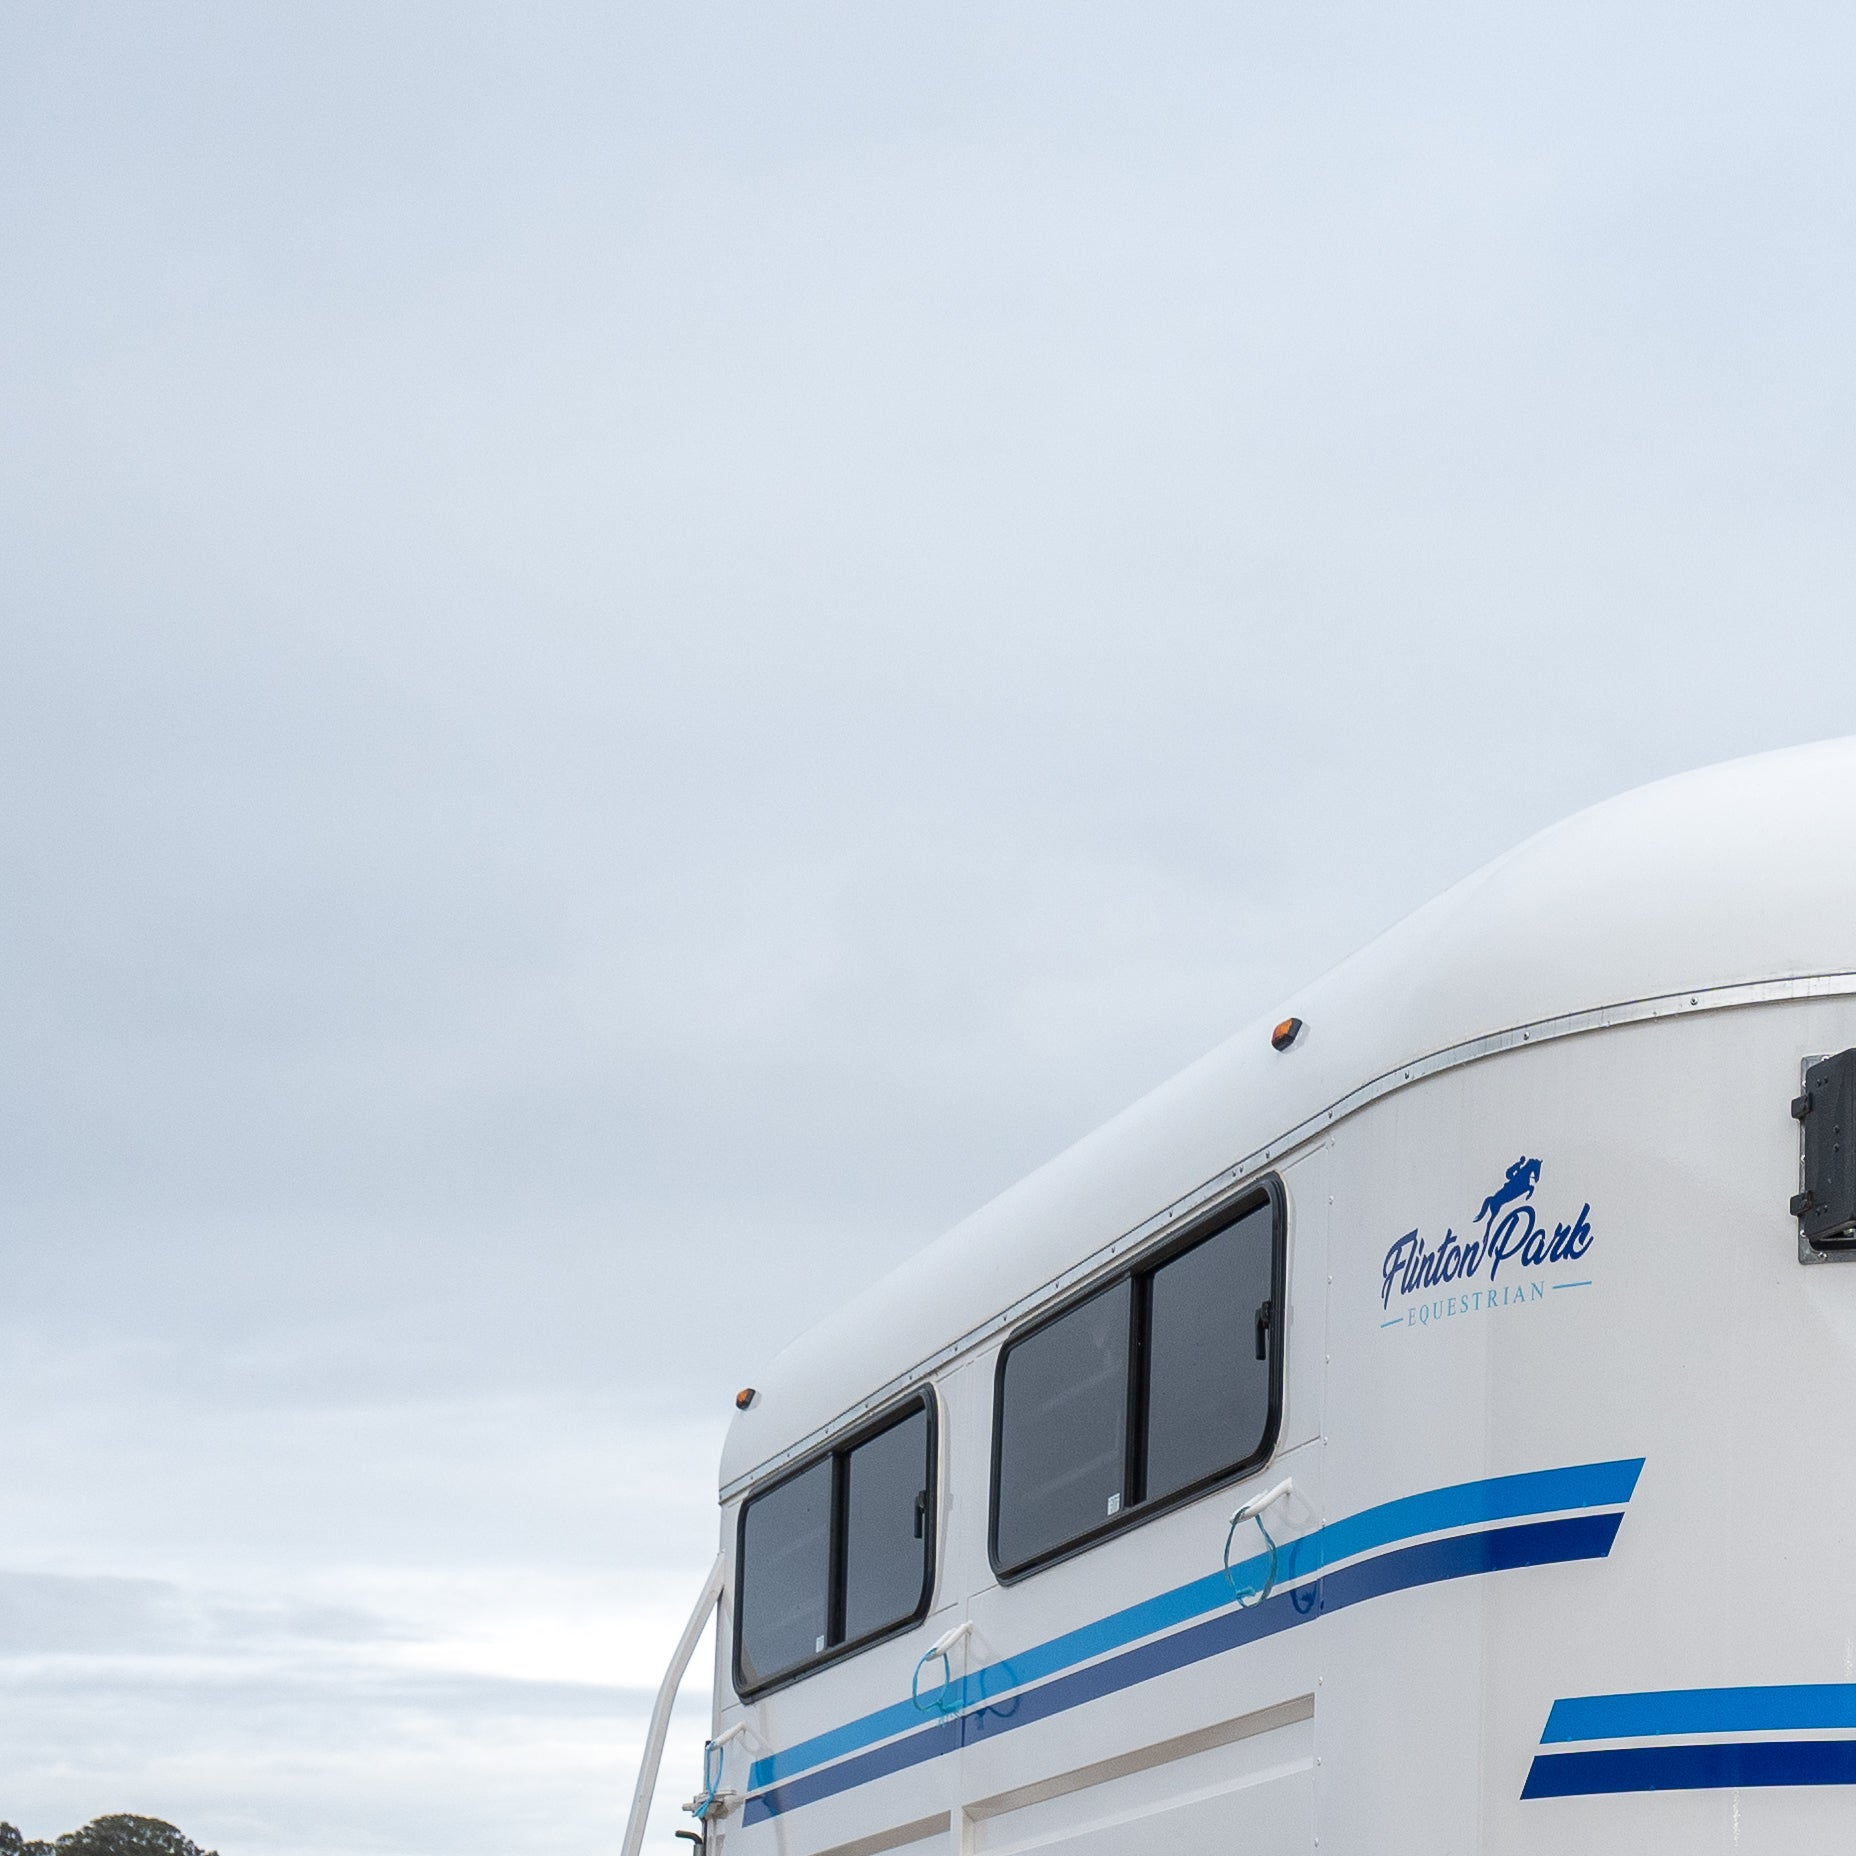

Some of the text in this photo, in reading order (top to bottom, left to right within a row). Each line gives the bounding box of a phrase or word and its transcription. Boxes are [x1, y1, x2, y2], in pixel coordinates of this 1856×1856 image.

[1381, 1203, 1594, 1310] Flinton Park
[1408, 1281, 1545, 1326] EQUESTRIAN
